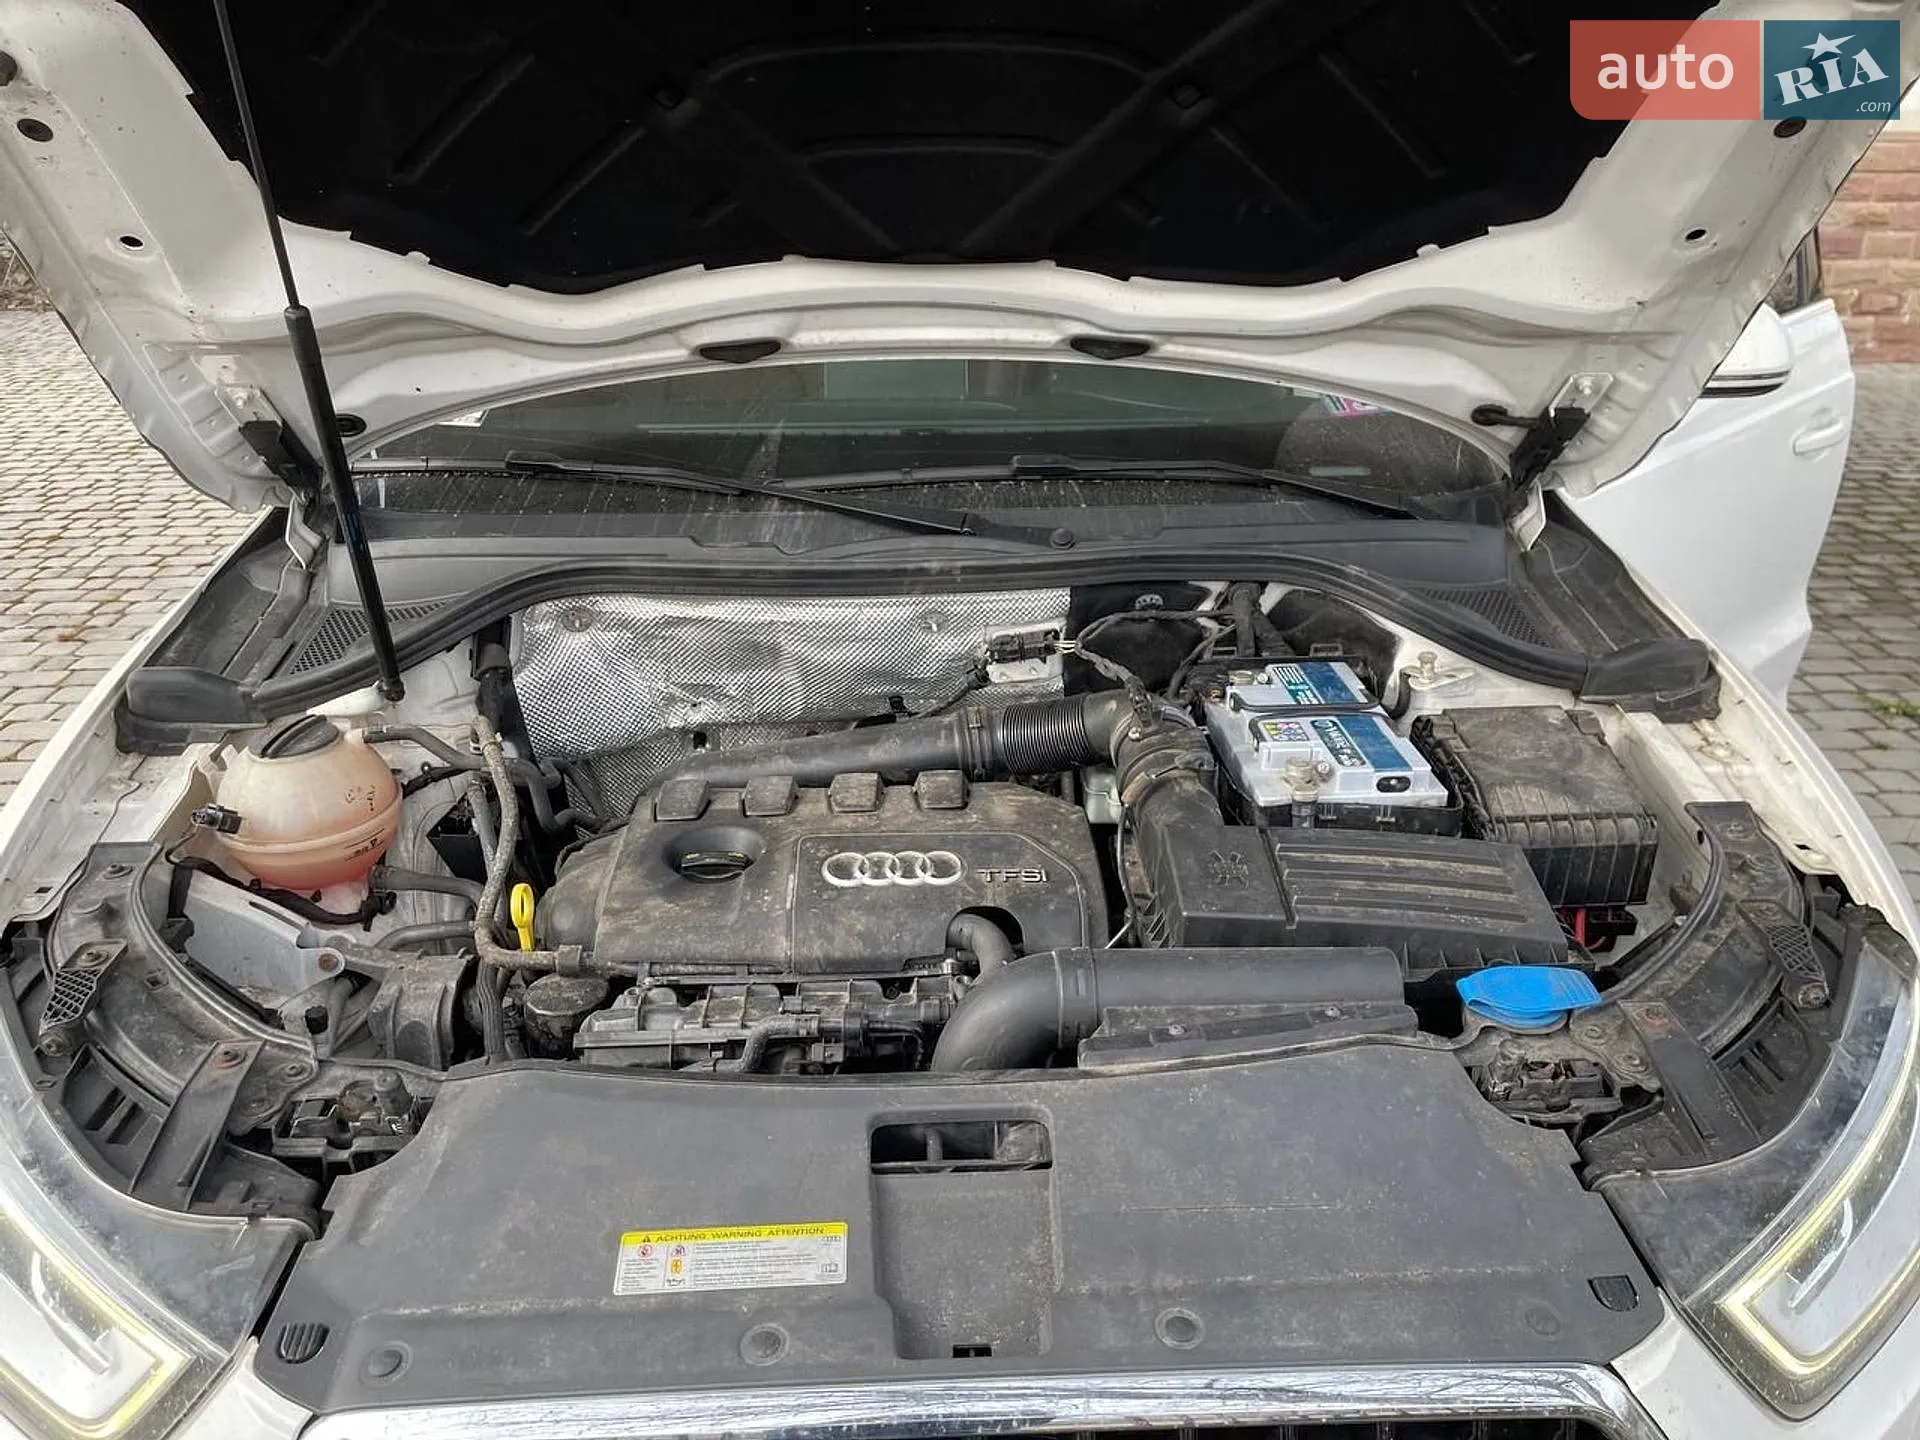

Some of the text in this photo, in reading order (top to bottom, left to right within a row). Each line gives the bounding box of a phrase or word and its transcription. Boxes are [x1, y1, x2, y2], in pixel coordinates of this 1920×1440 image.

[655, 1226, 825, 1243] ACHTUNG WARNING ATTENTION
